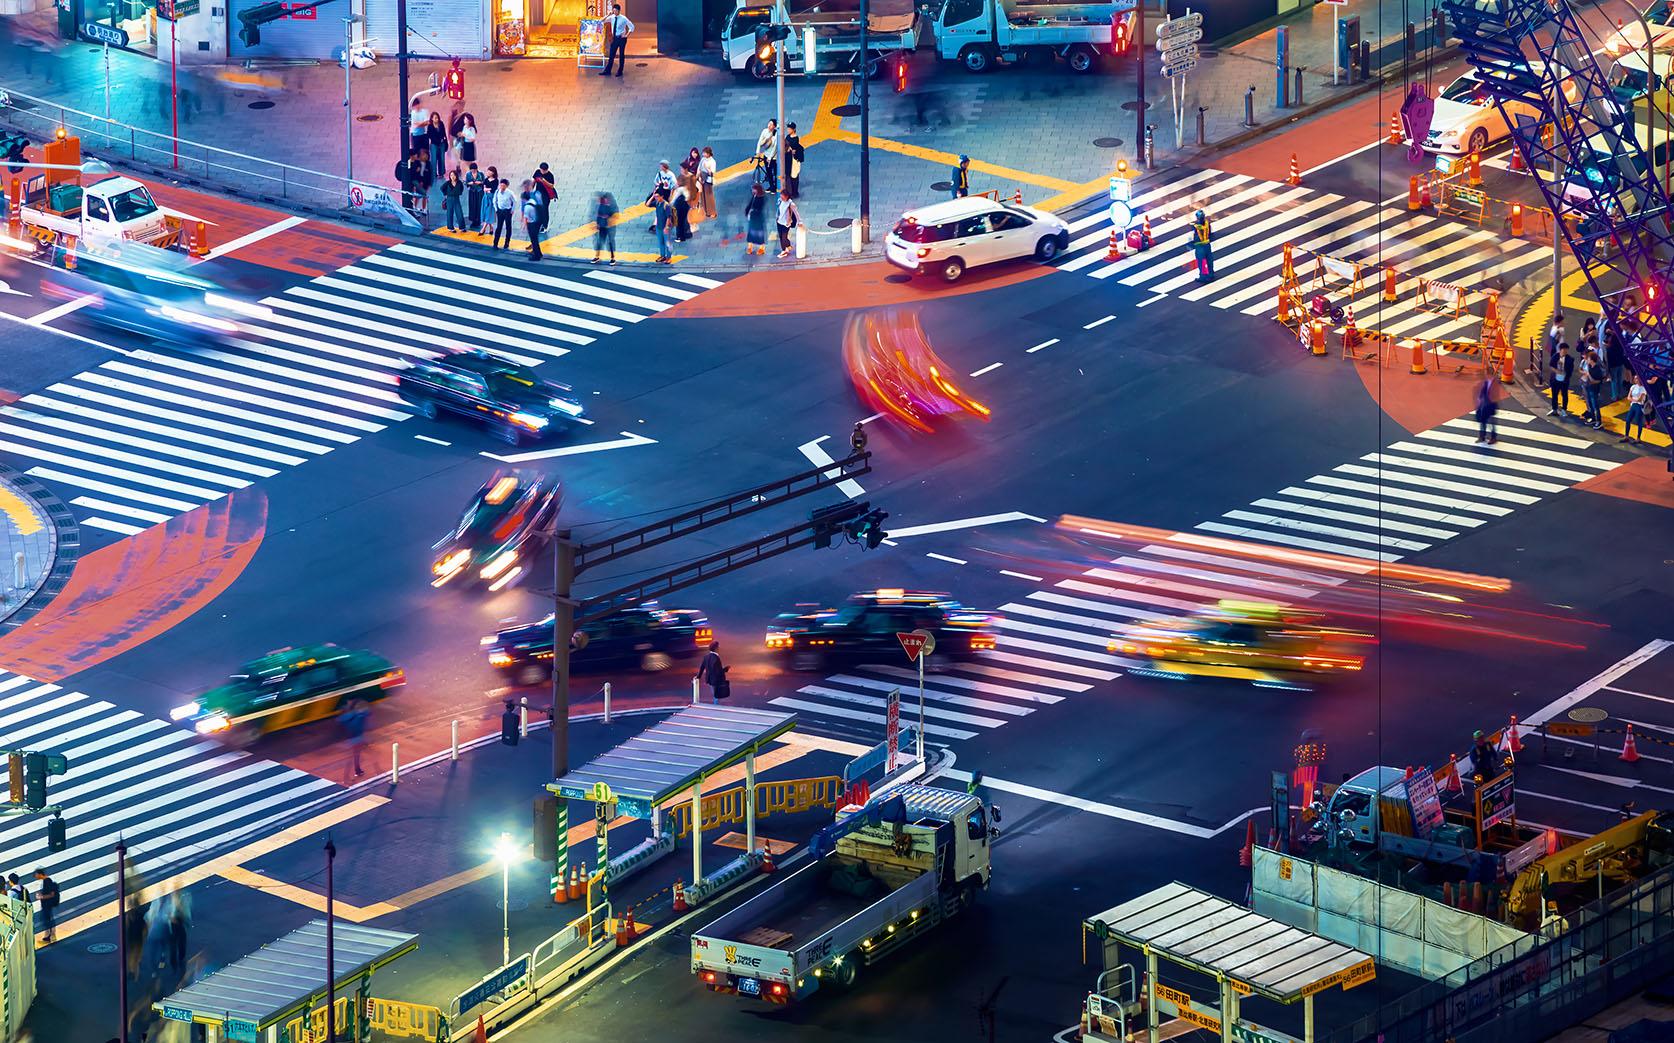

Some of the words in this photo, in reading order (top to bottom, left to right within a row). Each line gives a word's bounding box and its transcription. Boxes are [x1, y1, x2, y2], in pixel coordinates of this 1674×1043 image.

[903, 638, 922, 647] 止まれ
[888, 701, 899, 770] 横断禁止
[595, 783, 608, 801] 51
[1165, 988, 1190, 1007] 田町駅
